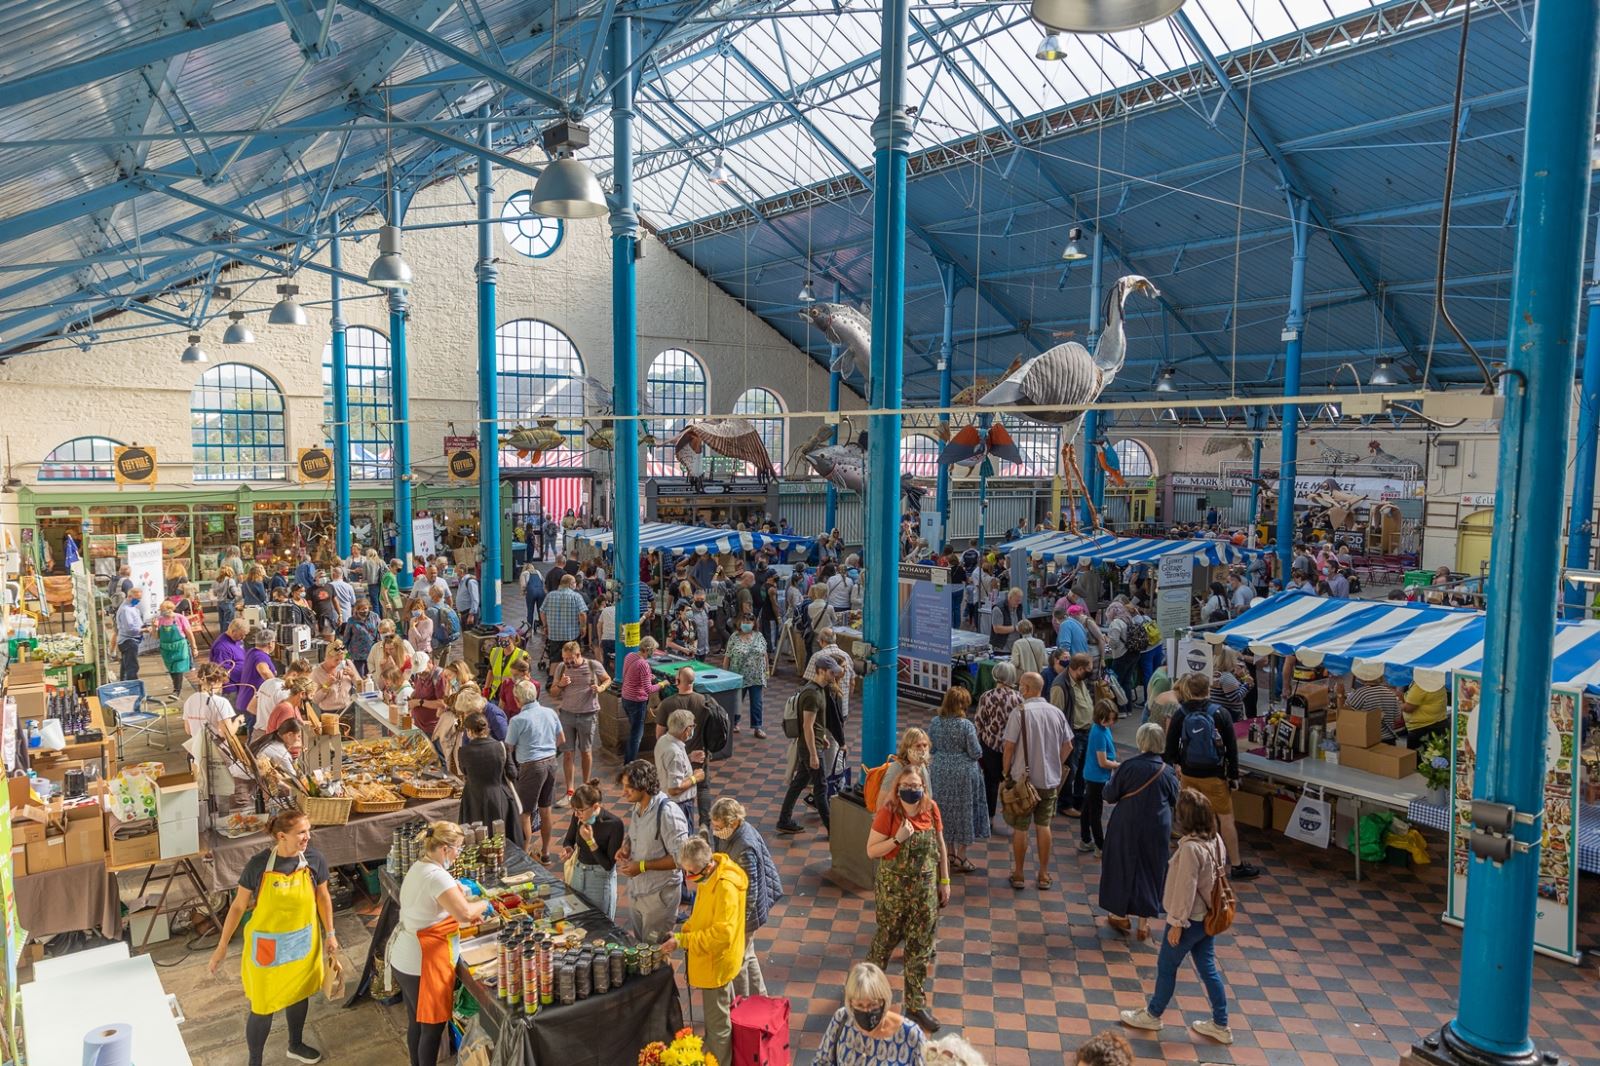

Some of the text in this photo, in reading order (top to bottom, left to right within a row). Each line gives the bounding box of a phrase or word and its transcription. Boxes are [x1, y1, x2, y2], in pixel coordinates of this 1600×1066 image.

[1295, 481, 1356, 491] HE MKET
[898, 565, 931, 575] AYHAWK
